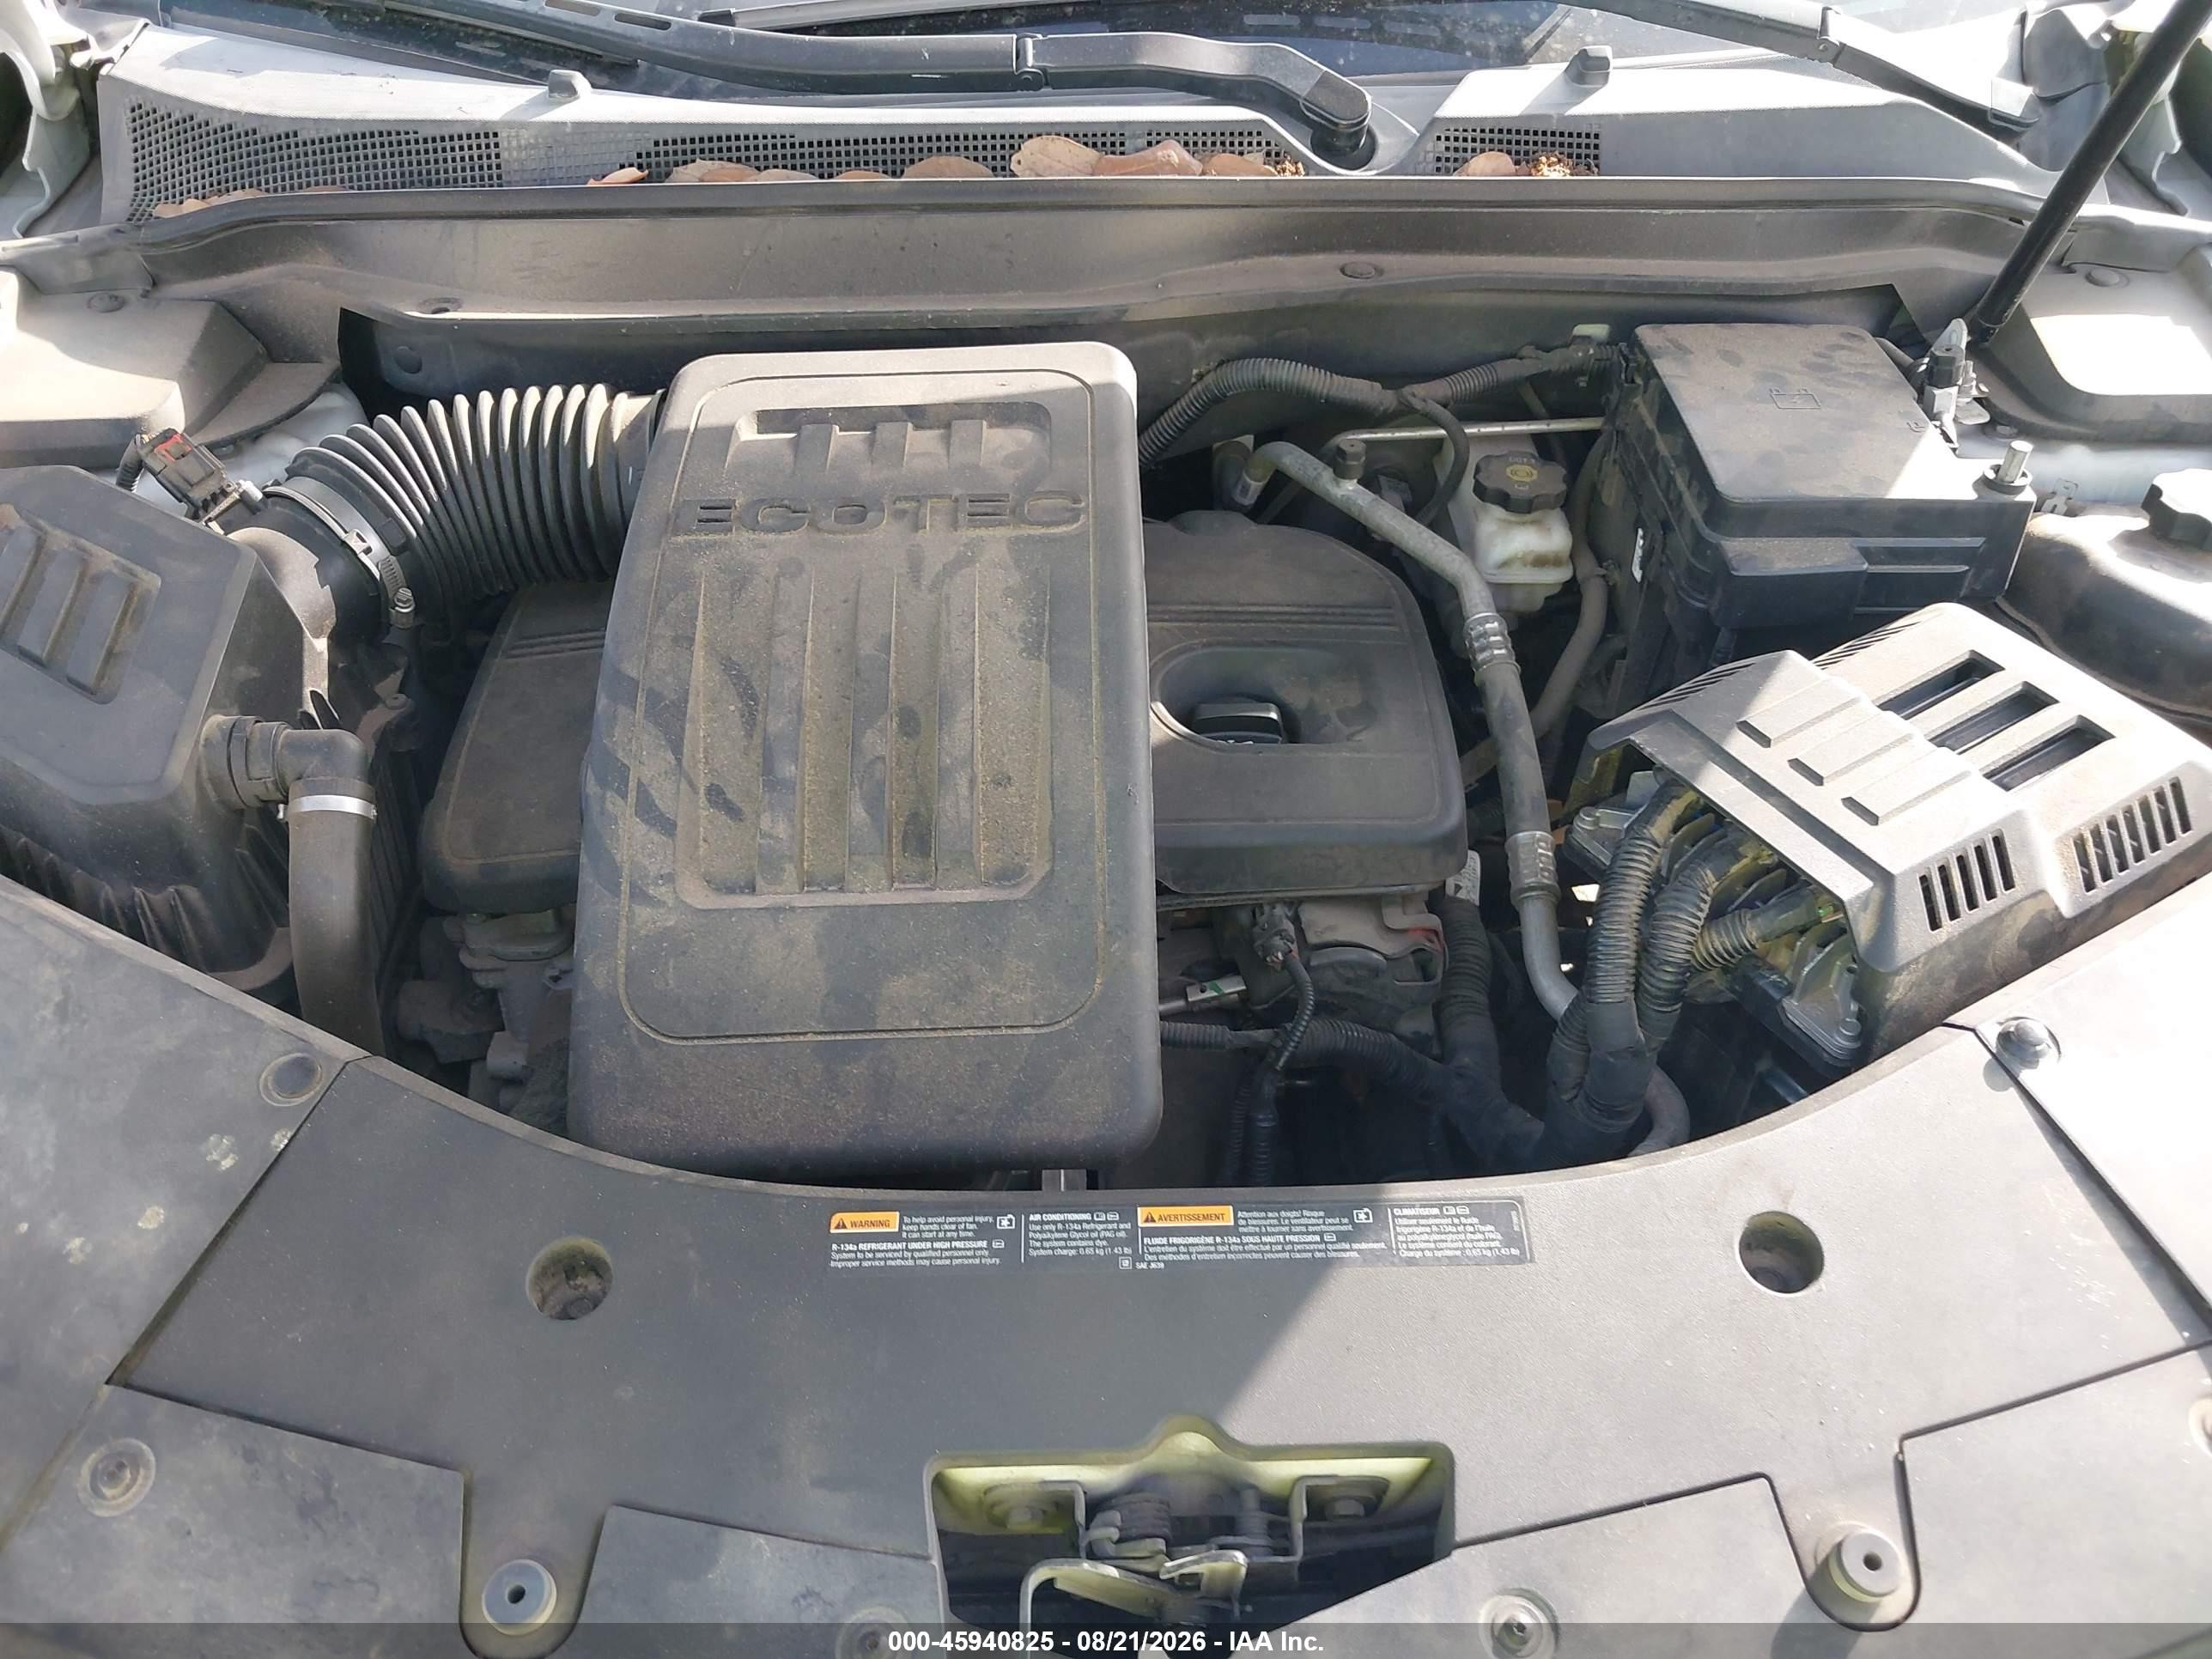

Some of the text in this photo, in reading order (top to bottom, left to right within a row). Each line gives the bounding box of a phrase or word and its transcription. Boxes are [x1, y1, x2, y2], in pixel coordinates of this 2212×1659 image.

[675, 491, 1086, 538] ECOTEC
[1303, 1209, 1325, 1218] Risque
[1394, 1207, 1440, 1216] CLIMATISEUR
[912, 1216, 926, 1224] help
[1042, 1212, 1091, 1221] CONDITIONING
[1158, 1212, 1225, 1222] AVERTISSEMENT
[1460, 1216, 1480, 1224] fluide
[850, 1219, 890, 1228] WARNING
[1042, 1223, 1056, 1231] only
[1083, 1222, 1118, 1231] Refrigerant
[1431, 1224, 1457, 1233] R-134a
[1070, 1231, 1089, 1239] Glycol
[1099, 1230, 1115, 1238] (PAG
[1042, 1240, 1066, 1249] system
[1144, 1237, 1168, 1245] FLUIDE
[1169, 1235, 1215, 1244] FRIGORIGÈNE
[1242, 1235, 1261, 1243] SOUS
[1261, 1235, 1285, 1243] HAUTE
[859, 1242, 907, 1250] REFRIGERANT
[951, 1240, 988, 1249] PRESSURE
[1294, 1243, 1326, 1252] personnel
[831, 1252, 855, 1261] System
[875, 1250, 902, 1259] serviced
[903, 1250, 912, 1259] by
[914, 1249, 941, 1259] qualified
[1029, 1249, 1053, 1257] System
[1096, 1247, 1104, 1255] kg
[1264, 1252, 1290, 1261] peuvent
[1400, 1249, 1424, 1258] Charge
[1482, 1248, 1492, 1257] kg
[830, 1260, 860, 1269] Improper
[951, 1257, 981, 1266] personal
